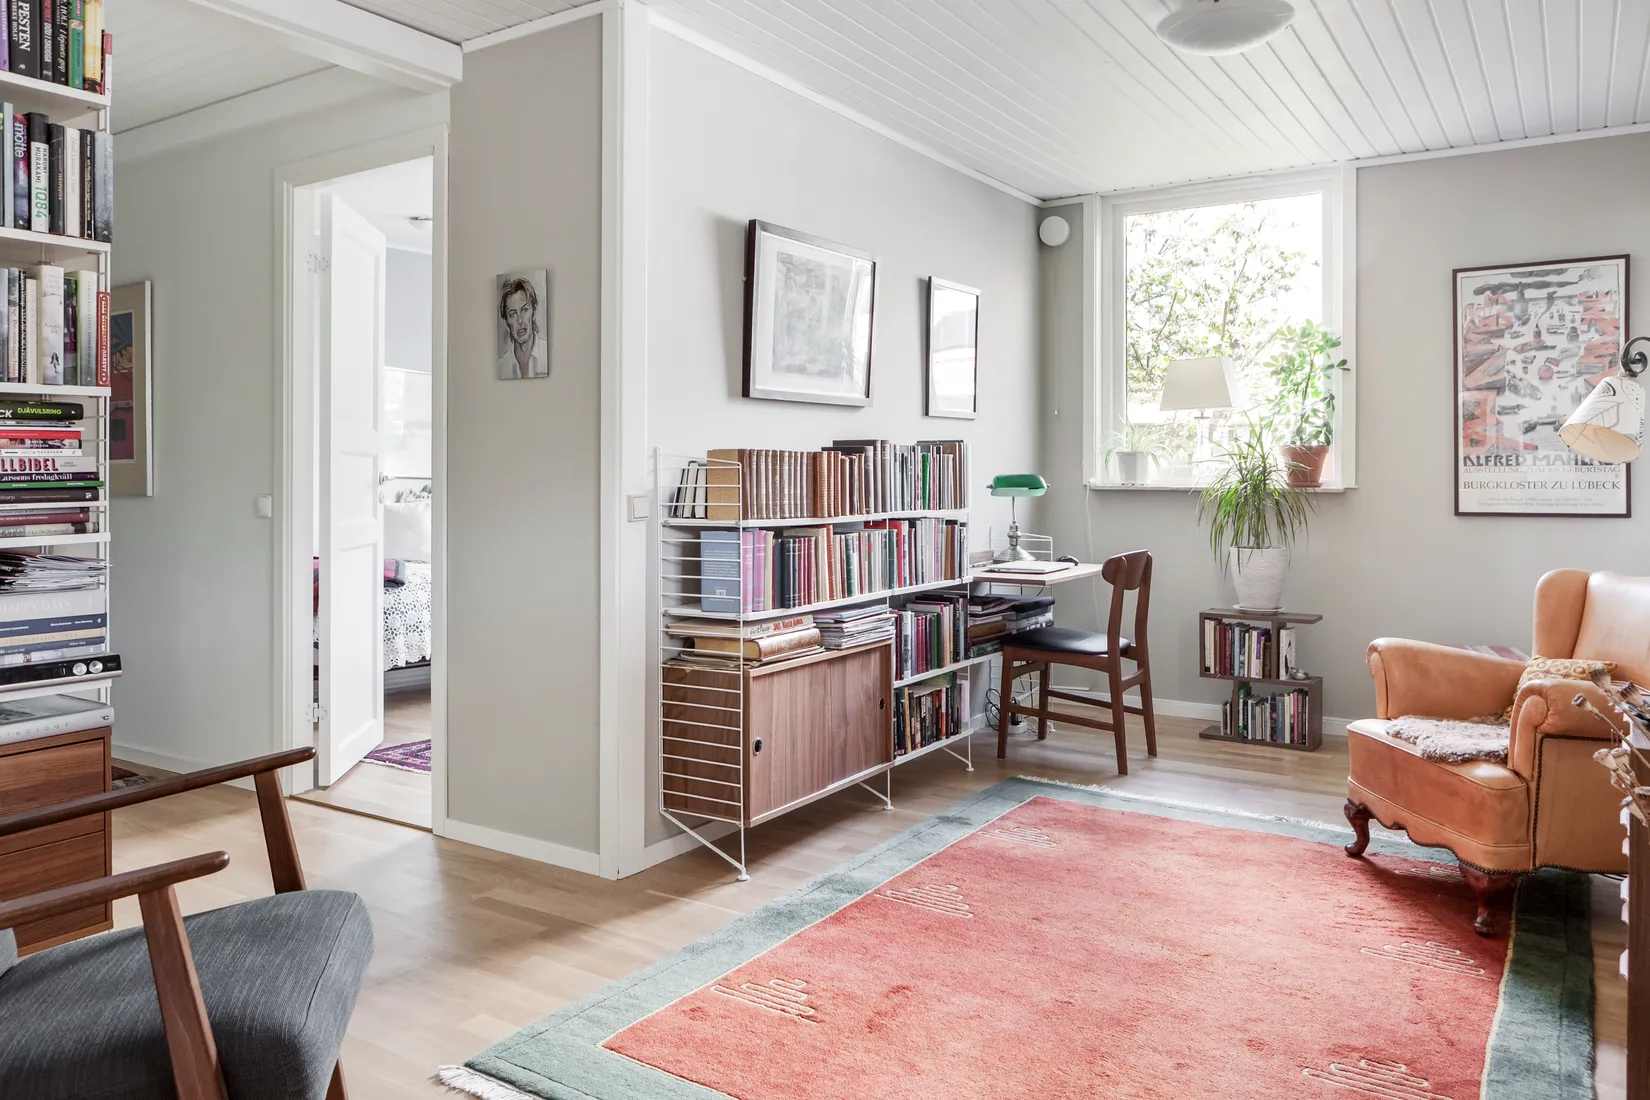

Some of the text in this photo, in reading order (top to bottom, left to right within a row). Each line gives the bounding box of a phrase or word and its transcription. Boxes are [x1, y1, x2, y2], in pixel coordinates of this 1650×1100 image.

[60, 6, 68, 27] HOLT
[18, 1, 30, 52] PESTEN
[14, 122, 27, 158] motte
[35, 186, 47, 218] 1Q84
[17, 406, 62, 415] DJÄVULSRING
[1463, 454, 1529, 467] ALFRED
[1463, 466, 1523, 474] AUSSTELLUNG
[32, 473, 72, 481] fredagkväll
[1463, 478, 1621, 490] BURGKLOSTER ZU LÜBECK
[41, 599, 72, 610] DAYS
[0, 723, 69, 738] THOLOGY
